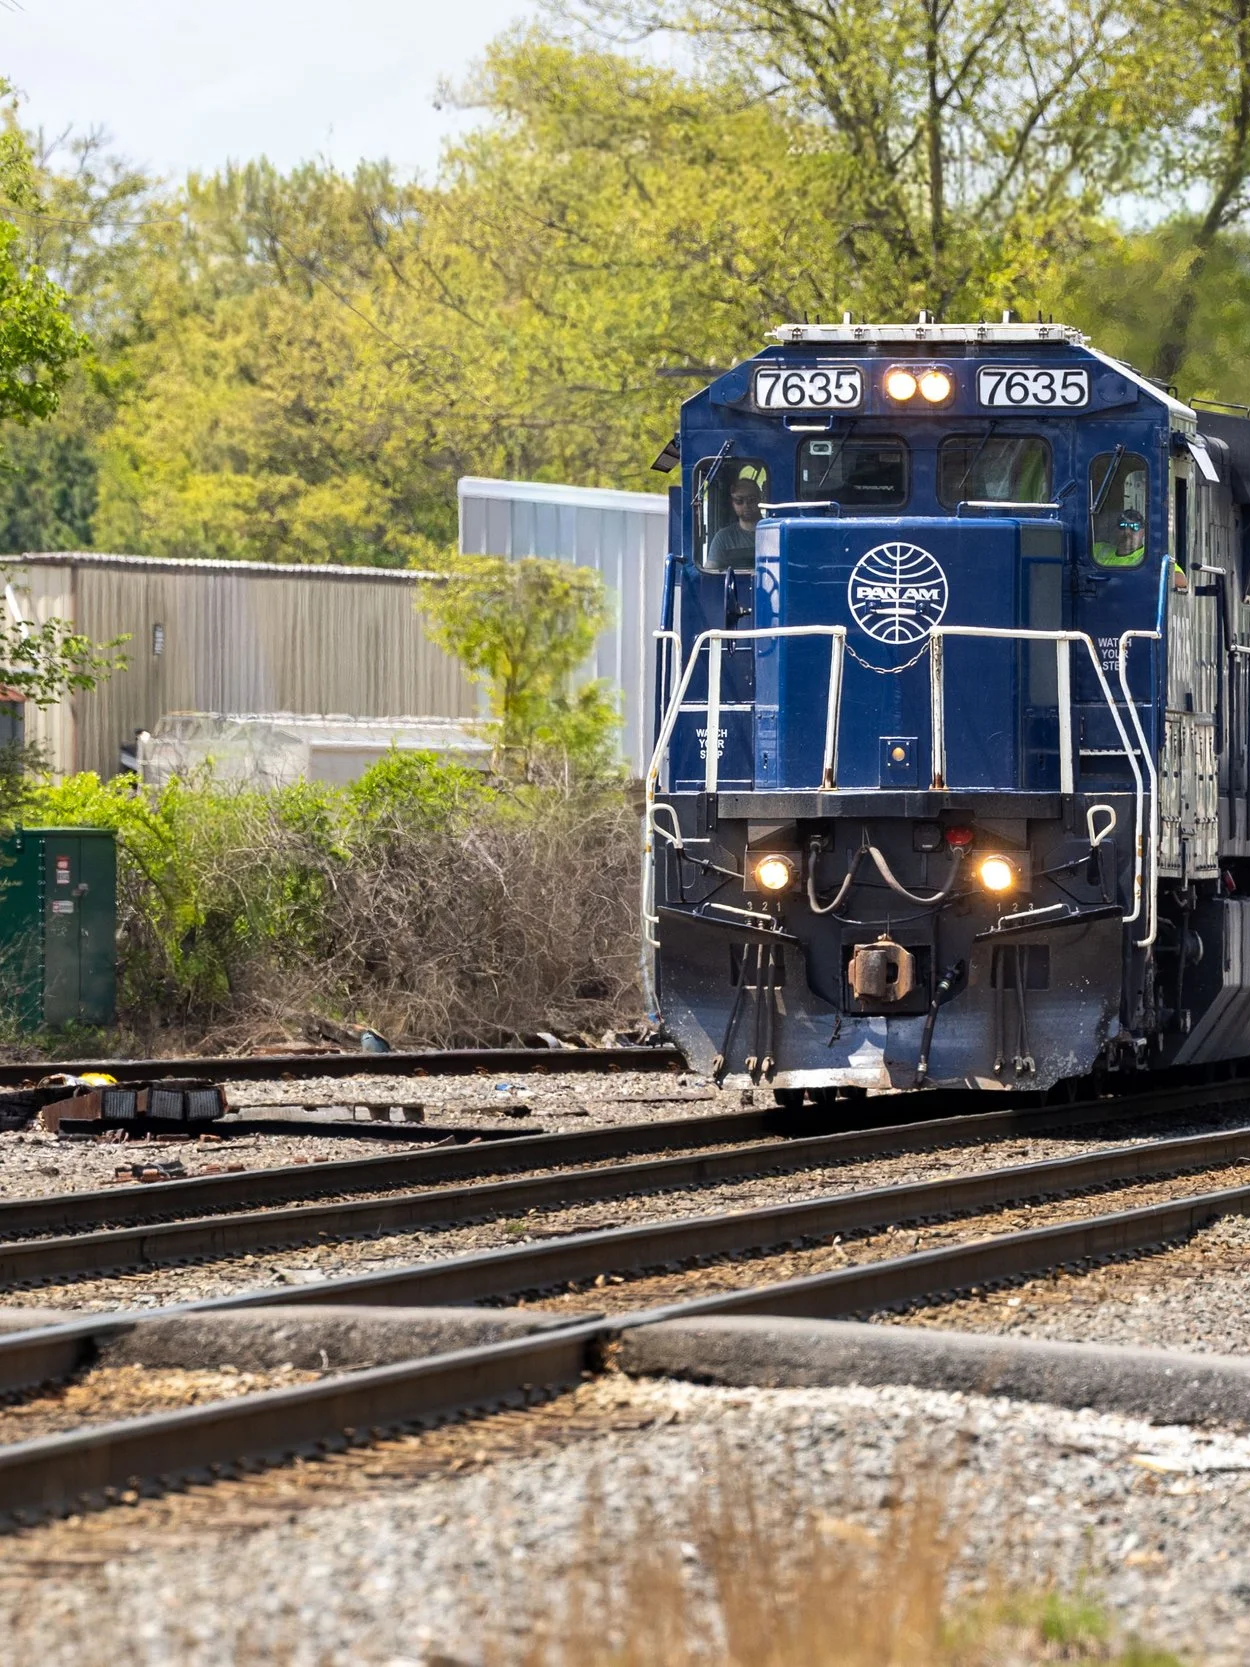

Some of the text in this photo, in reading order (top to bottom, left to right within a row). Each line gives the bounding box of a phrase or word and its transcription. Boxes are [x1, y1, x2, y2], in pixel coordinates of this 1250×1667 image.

[759, 371, 858, 407] 7635
[982, 371, 1086, 405] 7635
[856, 586, 941, 601] PAN AM
[1098, 637, 1132, 648] WATH
[1102, 660, 1127, 671] STE
[700, 749, 723, 760] SP
[746, 901, 781, 912] 3 2 1
[996, 902, 1034, 912] 1 2 3
